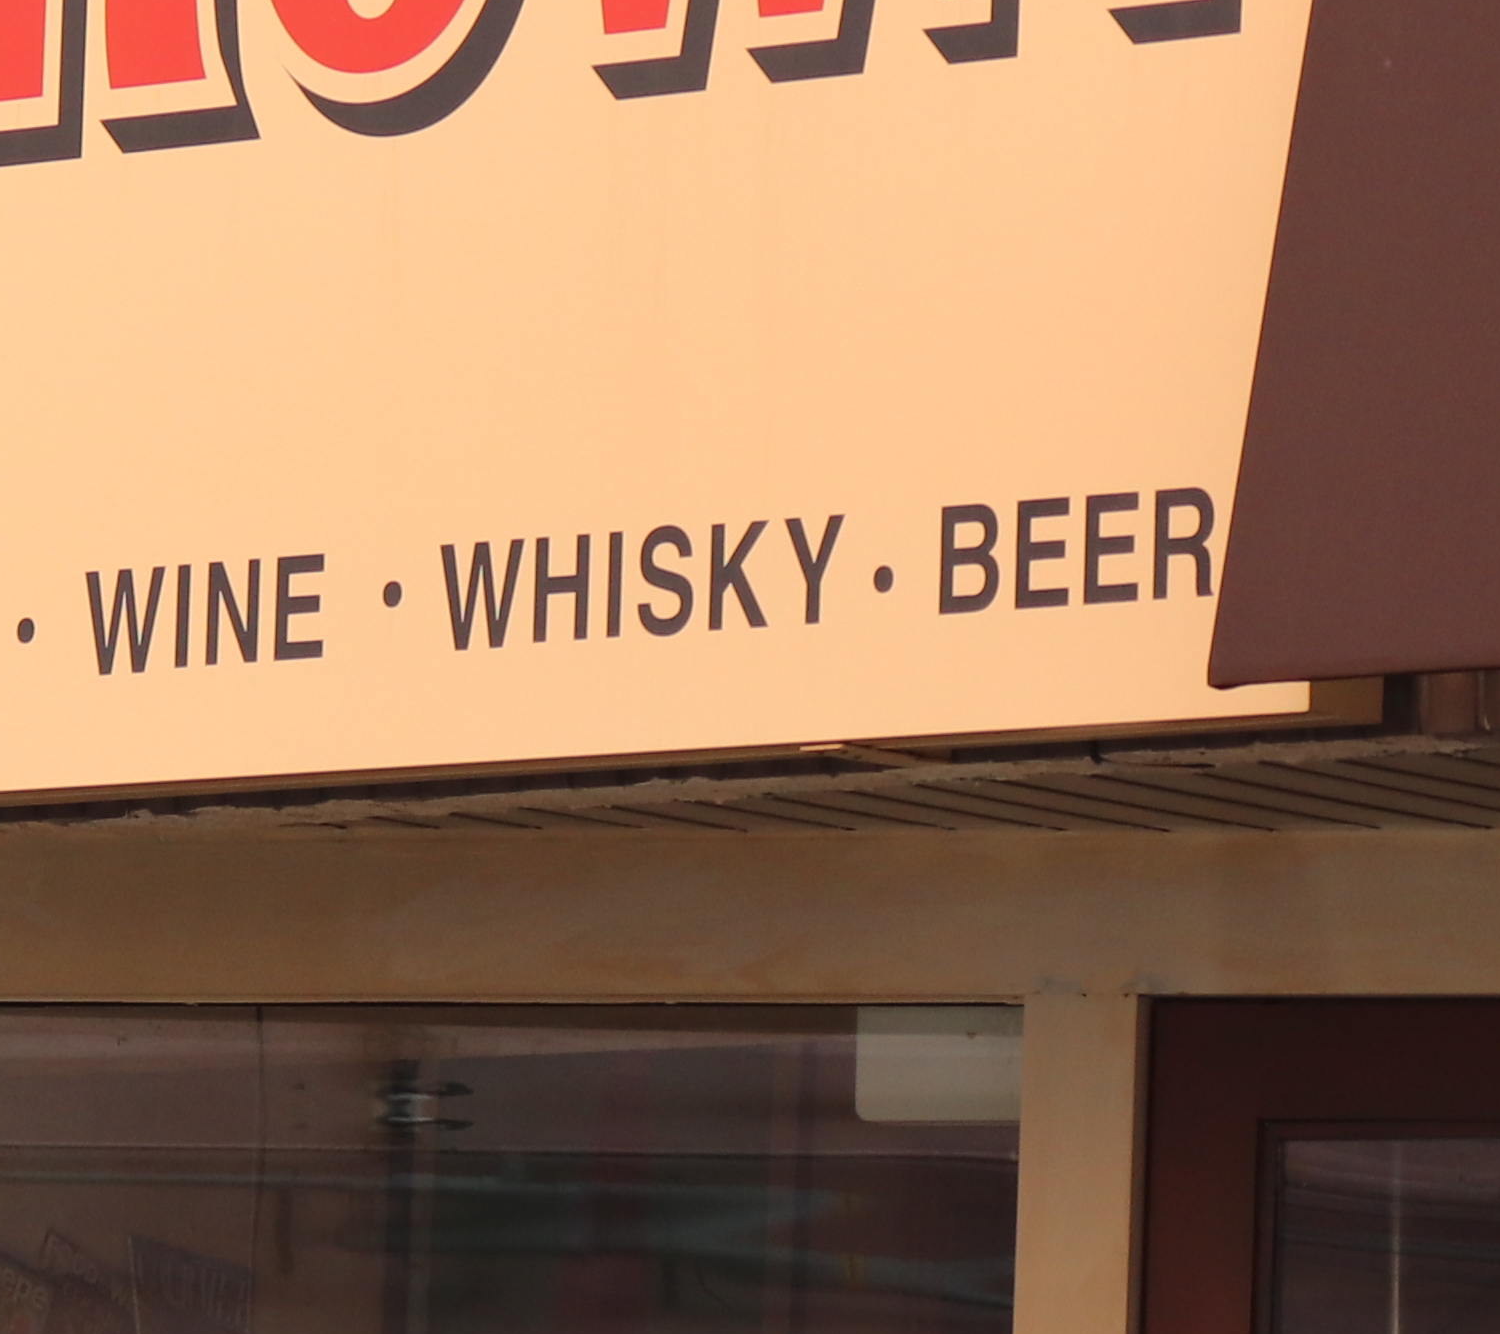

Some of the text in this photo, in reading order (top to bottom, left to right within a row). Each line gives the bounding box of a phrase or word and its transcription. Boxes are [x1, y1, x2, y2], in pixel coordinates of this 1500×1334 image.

[85, 553, 327, 676] WINE
[440, 513, 845, 651] WHISKY
[937, 486, 1217, 616] BEER
